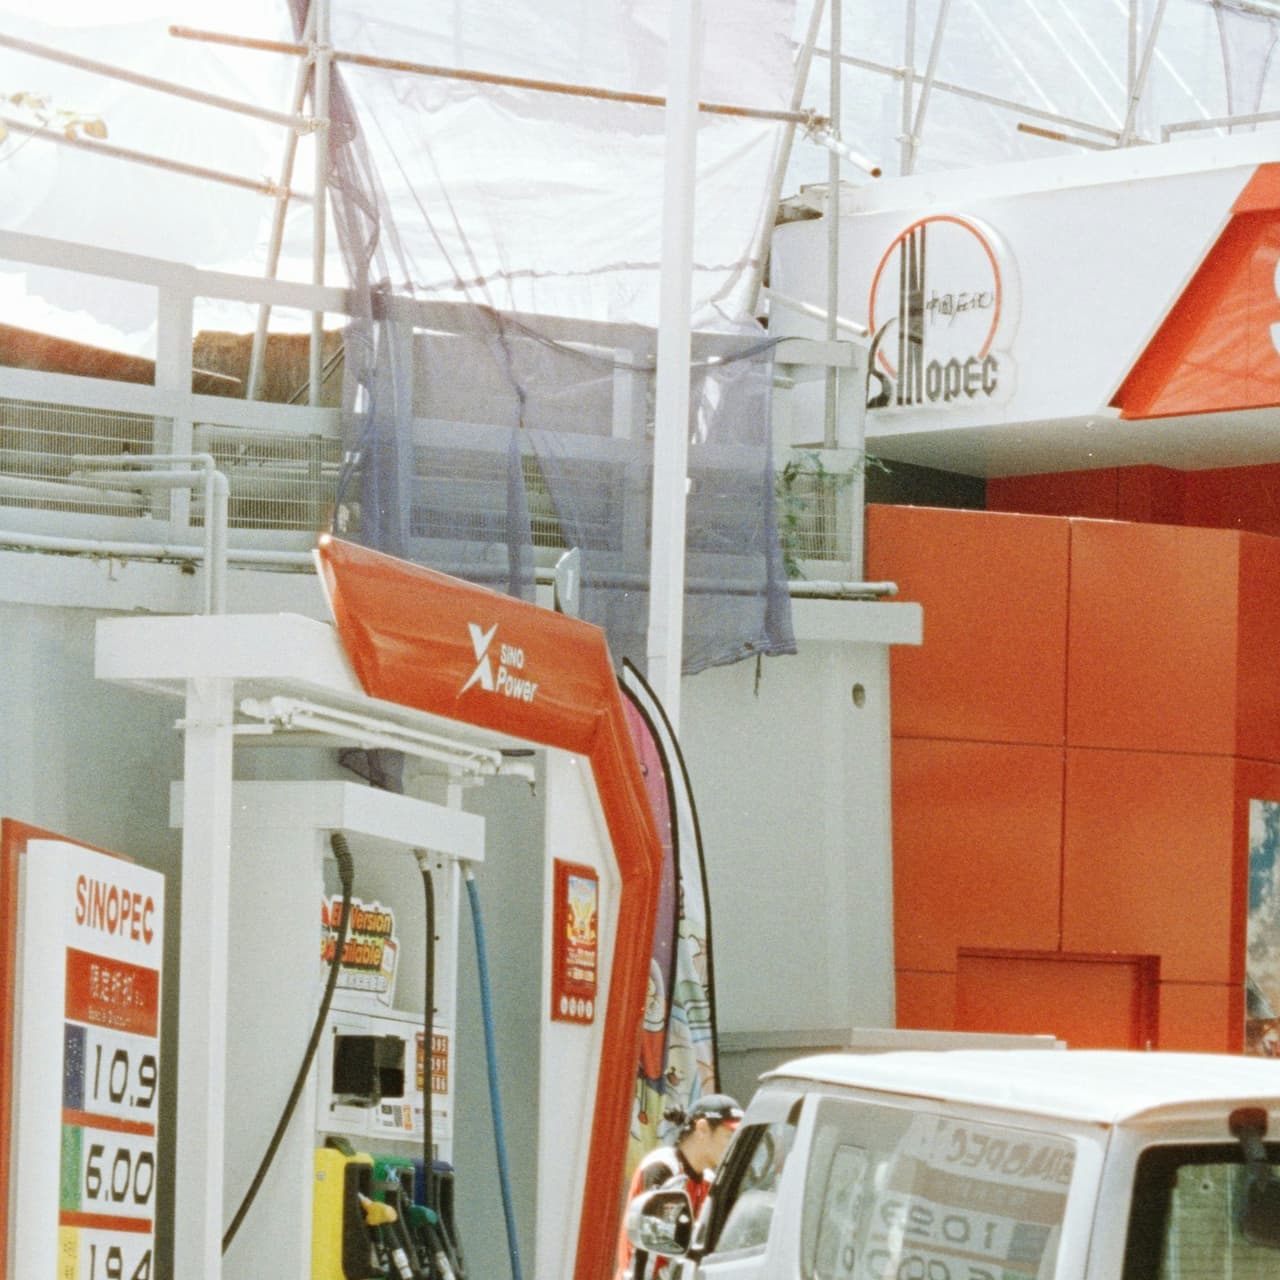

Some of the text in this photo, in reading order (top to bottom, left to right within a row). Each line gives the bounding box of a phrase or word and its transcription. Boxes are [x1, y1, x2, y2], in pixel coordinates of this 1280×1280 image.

[501, 643, 525, 669] SINO
[496, 665, 538, 704] Power
[75, 874, 155, 945] SINOPEC
[326, 938, 381, 966] Aailable
